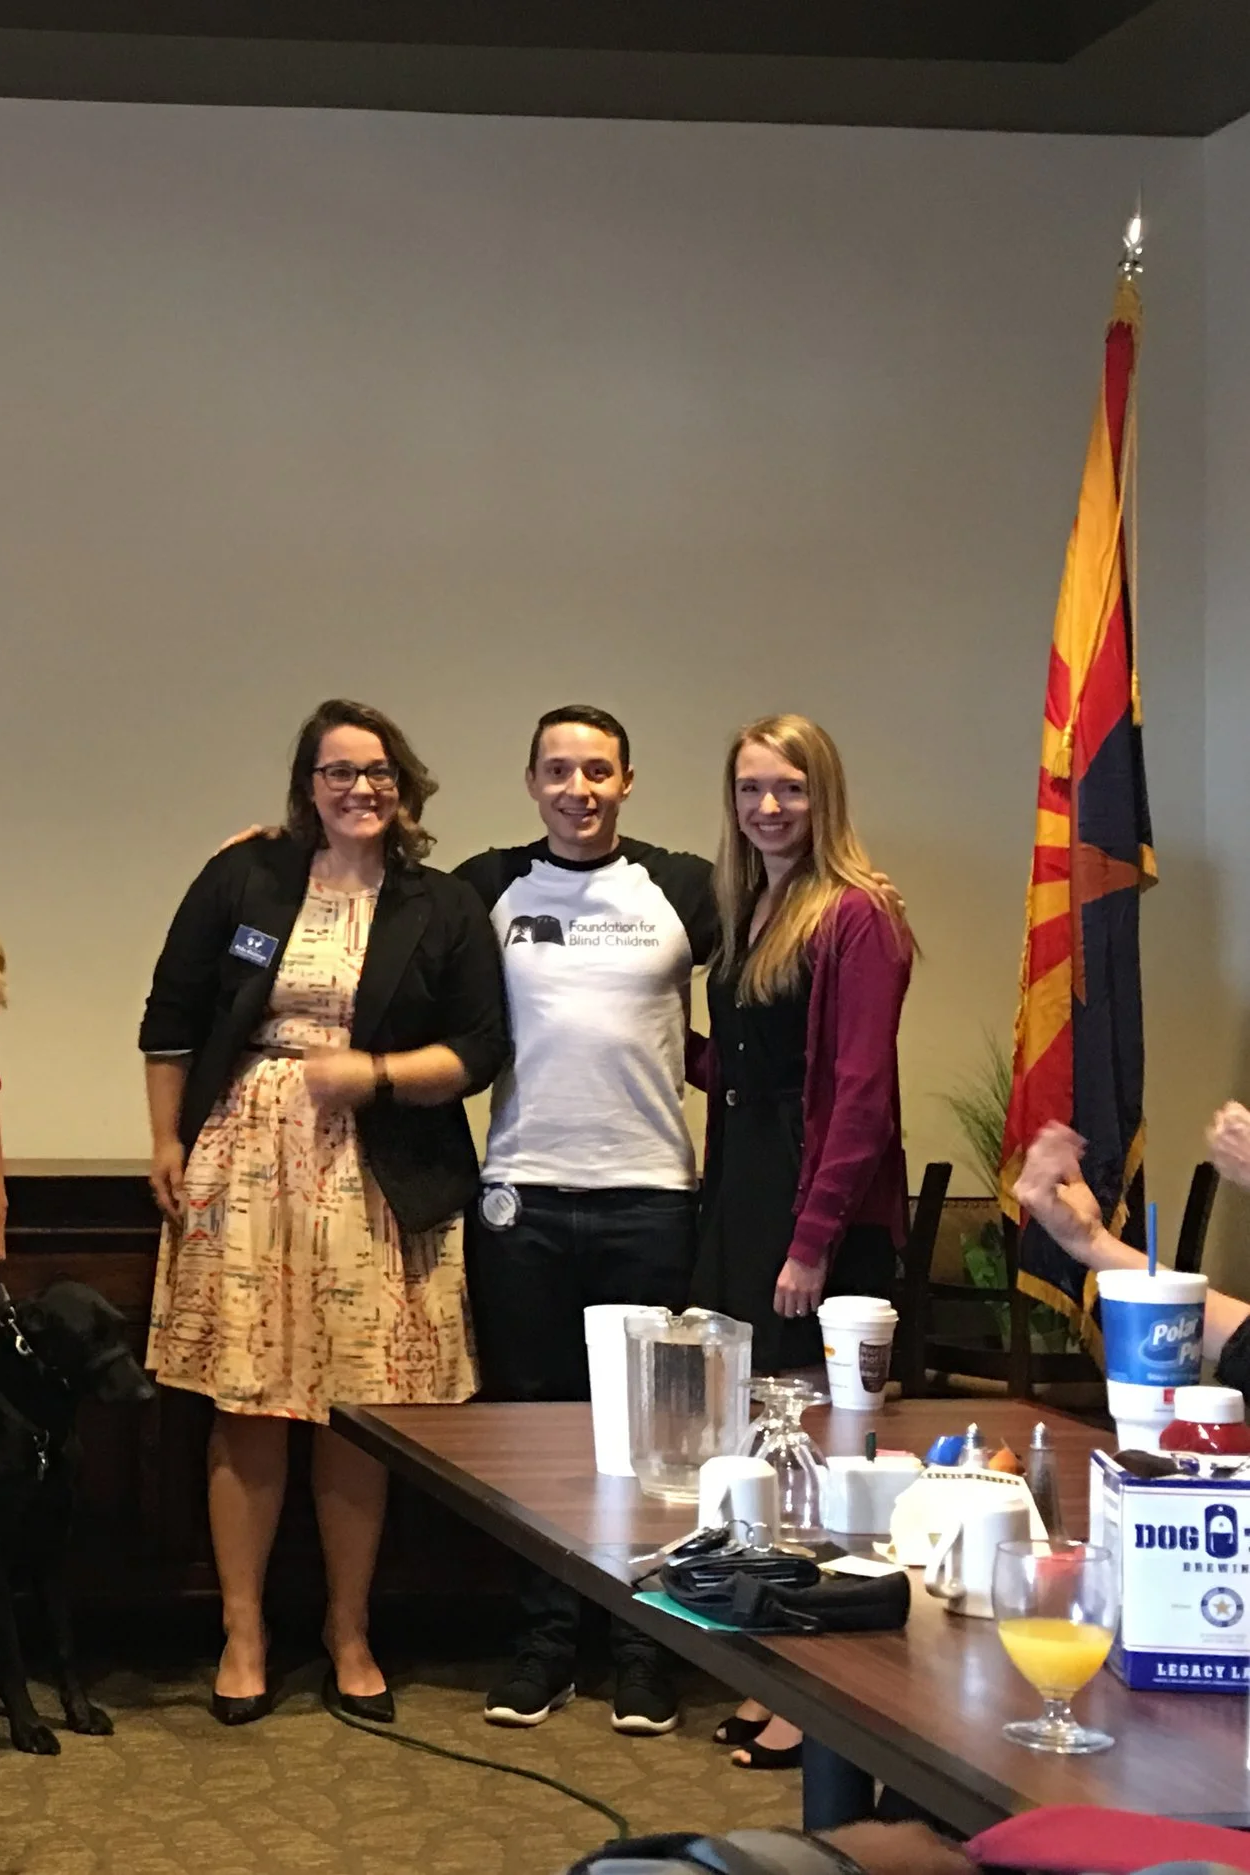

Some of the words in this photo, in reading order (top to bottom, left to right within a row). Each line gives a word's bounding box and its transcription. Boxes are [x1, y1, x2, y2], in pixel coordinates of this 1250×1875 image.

[569, 919, 638, 932] Foundation
[639, 919, 656, 932] for
[568, 935, 599, 947] Blind
[605, 935, 659, 947] Children
[1152, 1317, 1198, 1346] Polar
[1134, 1523, 1200, 1551] DOG
[1157, 1662, 1225, 1679] LEGACY
